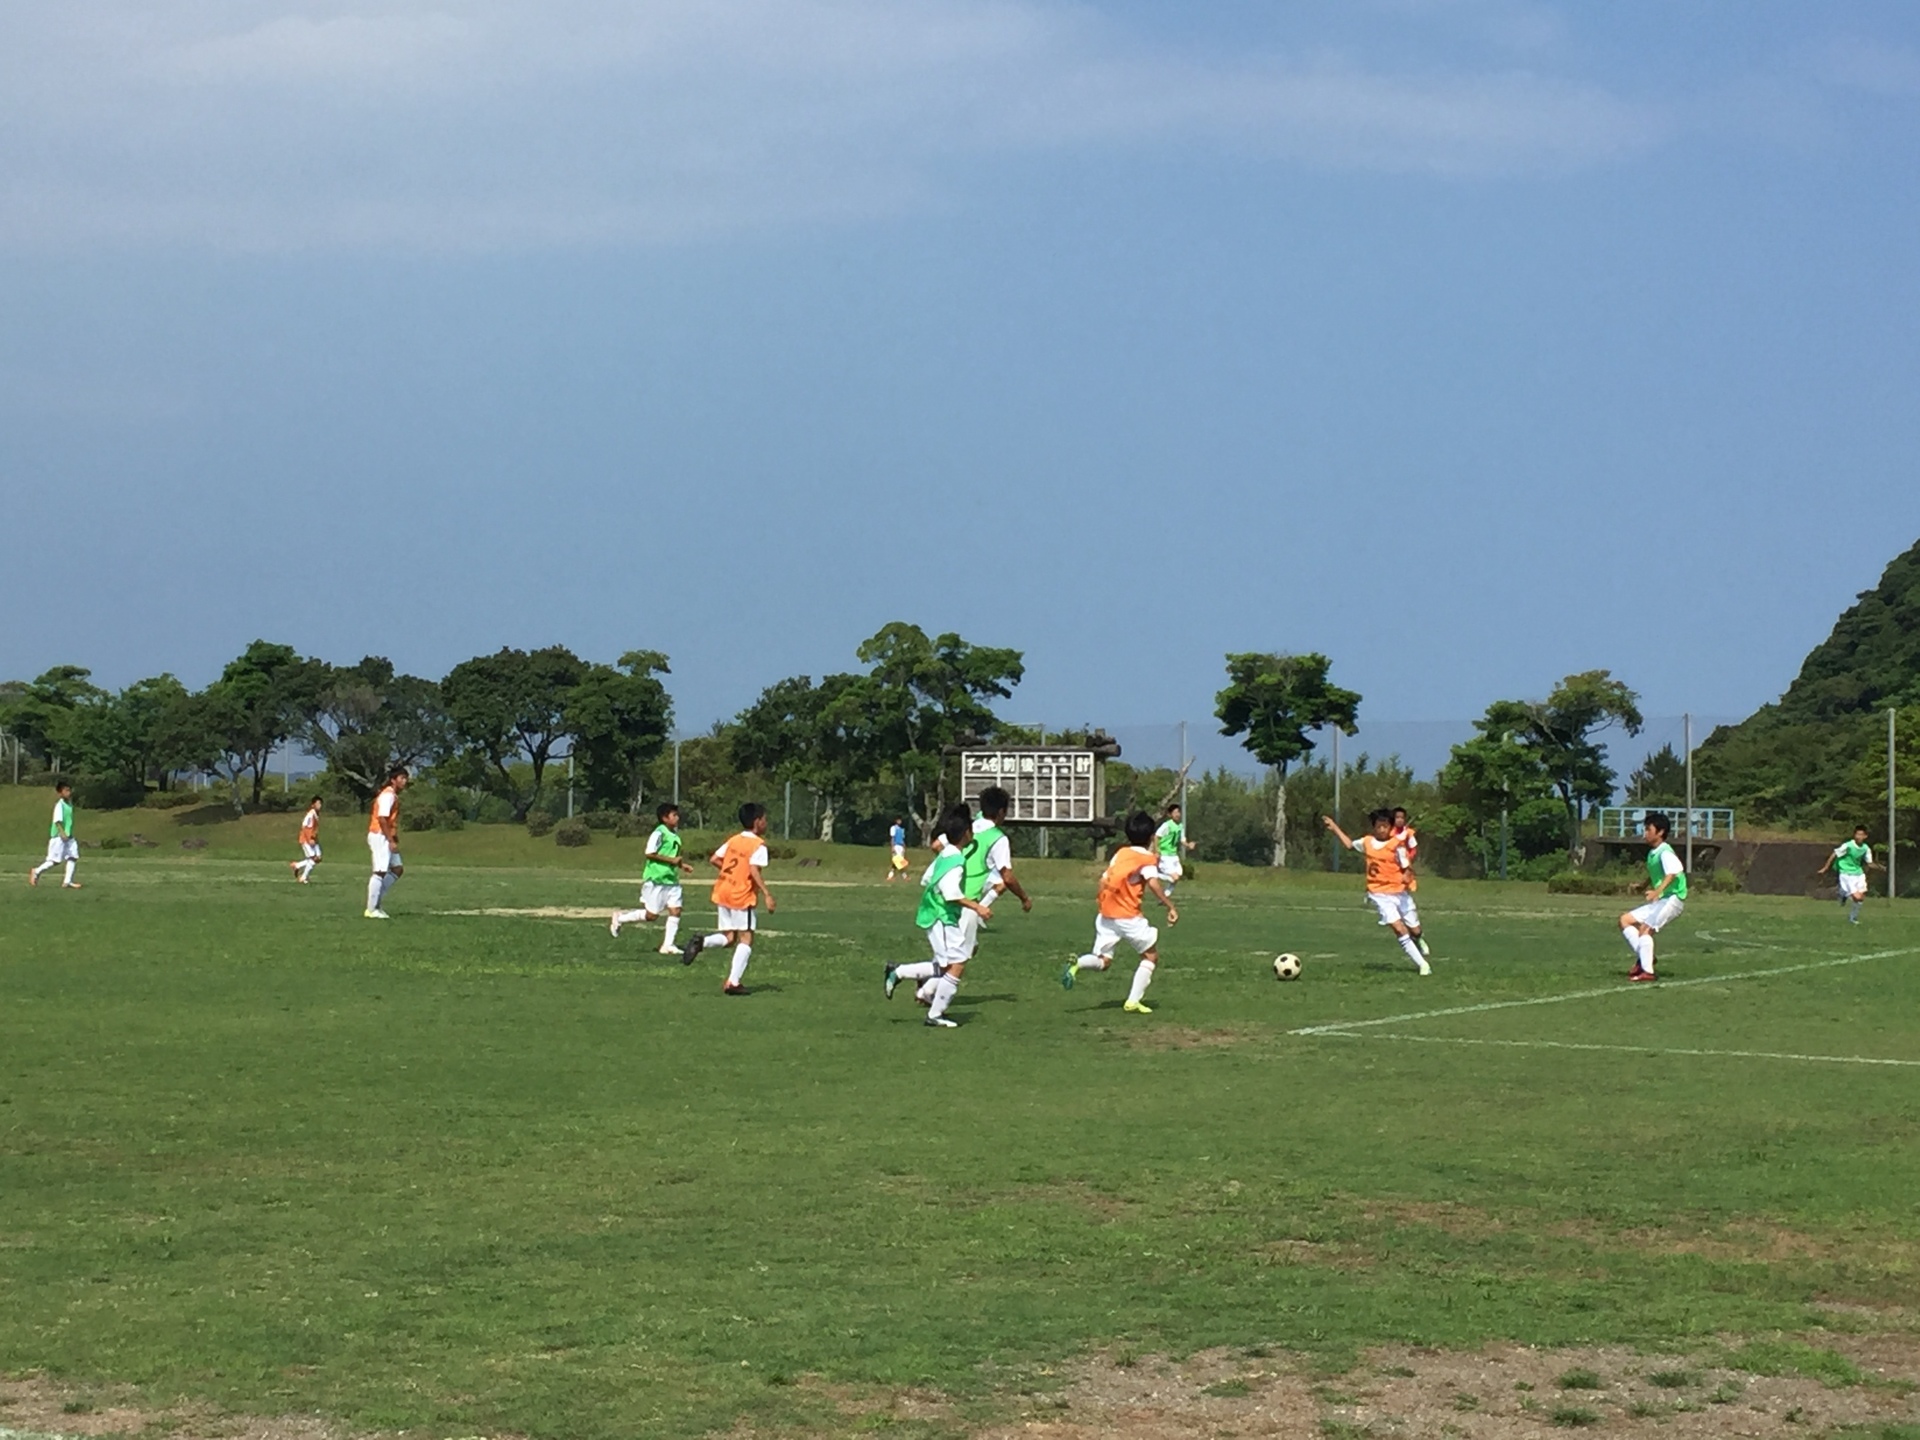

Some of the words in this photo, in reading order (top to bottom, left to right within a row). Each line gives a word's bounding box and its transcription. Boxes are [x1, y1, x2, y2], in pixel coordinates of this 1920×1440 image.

[966, 757, 998, 772] チーム名
[1003, 757, 1016, 772] 前
[1021, 757, 1034, 772] 後
[1076, 757, 1090, 772] 計
[723, 858, 738, 875] 2
